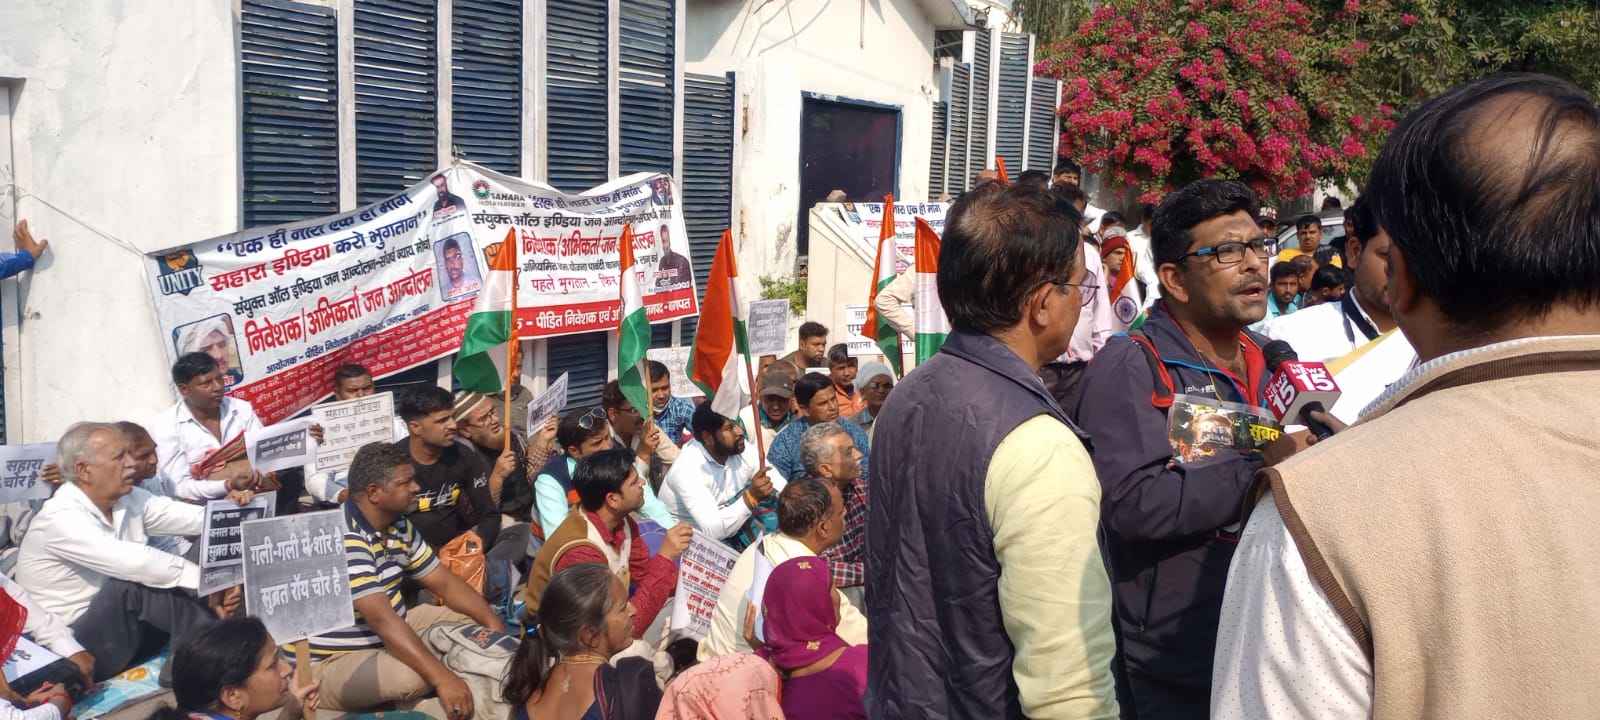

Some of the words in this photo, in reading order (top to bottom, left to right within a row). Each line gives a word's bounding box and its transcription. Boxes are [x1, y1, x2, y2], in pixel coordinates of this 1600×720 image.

[491, 193, 525, 202] SAHARA
[472, 210, 513, 229] संयुक्त
[513, 212, 541, 227] ऑल
[543, 212, 581, 228] इण्डिया
[584, 217, 602, 228] जन
[268, 228, 288, 249] ही
[601, 236, 617, 254] जन
[208, 262, 267, 291] सहारा
[271, 244, 331, 276] इण्डिया
[333, 231, 366, 254] करो
[158, 266, 204, 294] UNITY
[361, 287, 386, 312] जन
[387, 266, 434, 304] आन्दोलन
[531, 274, 555, 292] पहले
[558, 277, 589, 295] भुगतान
[233, 295, 267, 318] संयुक्त
[268, 285, 290, 305] ऑल
[290, 277, 322, 299] इण्डिया
[322, 271, 340, 287] जन
[565, 306, 597, 326] निवेशक
[599, 307, 610, 322] एवं
[266, 354, 298, 374] आयोजक
[1288, 363, 1303, 371] THE
[1291, 367, 1325, 375] NEWS
[1268, 371, 1287, 402] NEWS
[1296, 373, 1335, 391] 15
[1272, 379, 1295, 414] 15
[1249, 424, 1281, 442] सुब्रत
[6, 459, 46, 473] सहारा
[4, 472, 27, 489] चोर
[28, 470, 38, 489] है
[250, 532, 300, 566] गली-गली
[312, 528, 333, 556] शोर
[334, 526, 343, 556] है
[260, 583, 289, 616] सुब्रत
[290, 573, 310, 601] रॉय
[311, 569, 331, 597] चोर
[332, 566, 341, 597] है
